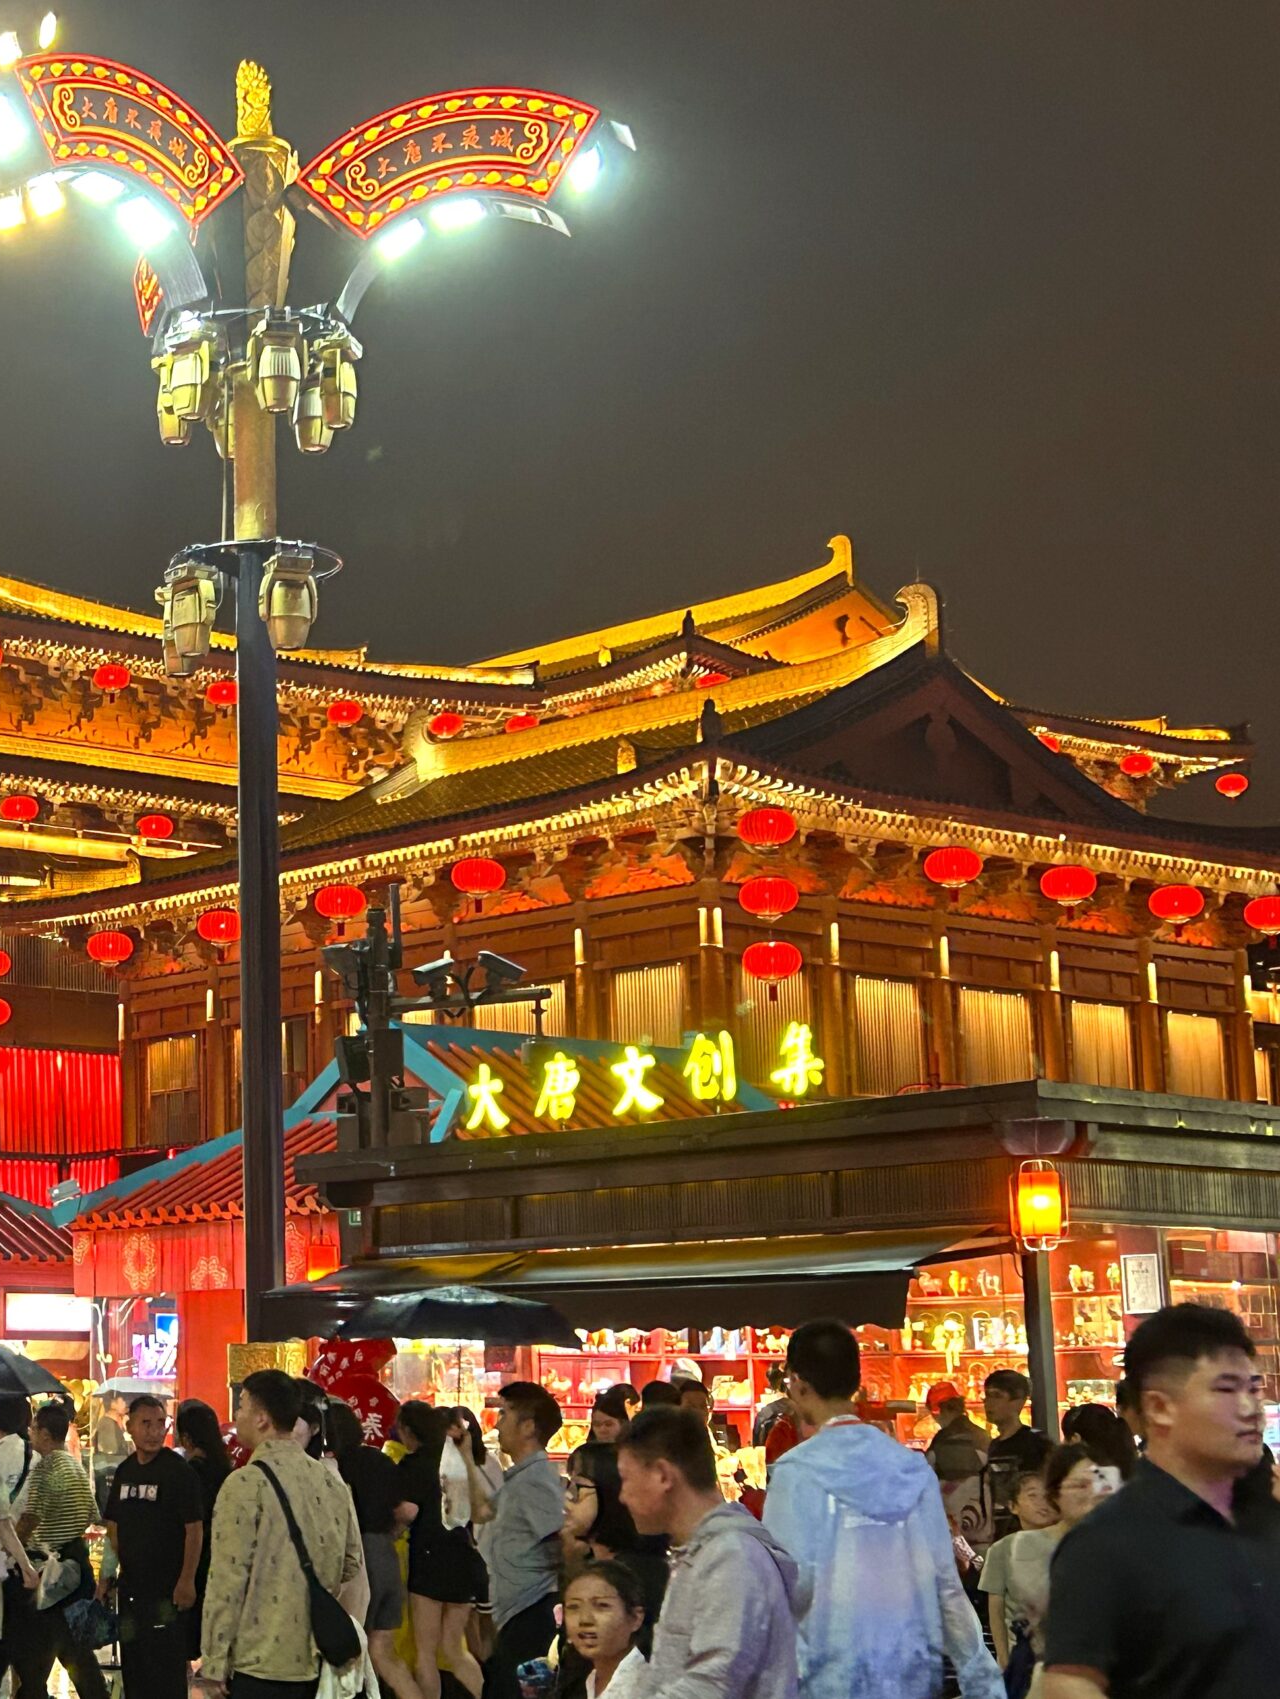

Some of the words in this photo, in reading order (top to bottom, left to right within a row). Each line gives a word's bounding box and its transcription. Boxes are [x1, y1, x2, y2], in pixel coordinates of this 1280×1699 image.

[377, 124, 515, 179] 大唐不夜城
[466, 1020, 825, 1131] 大唐文创集
